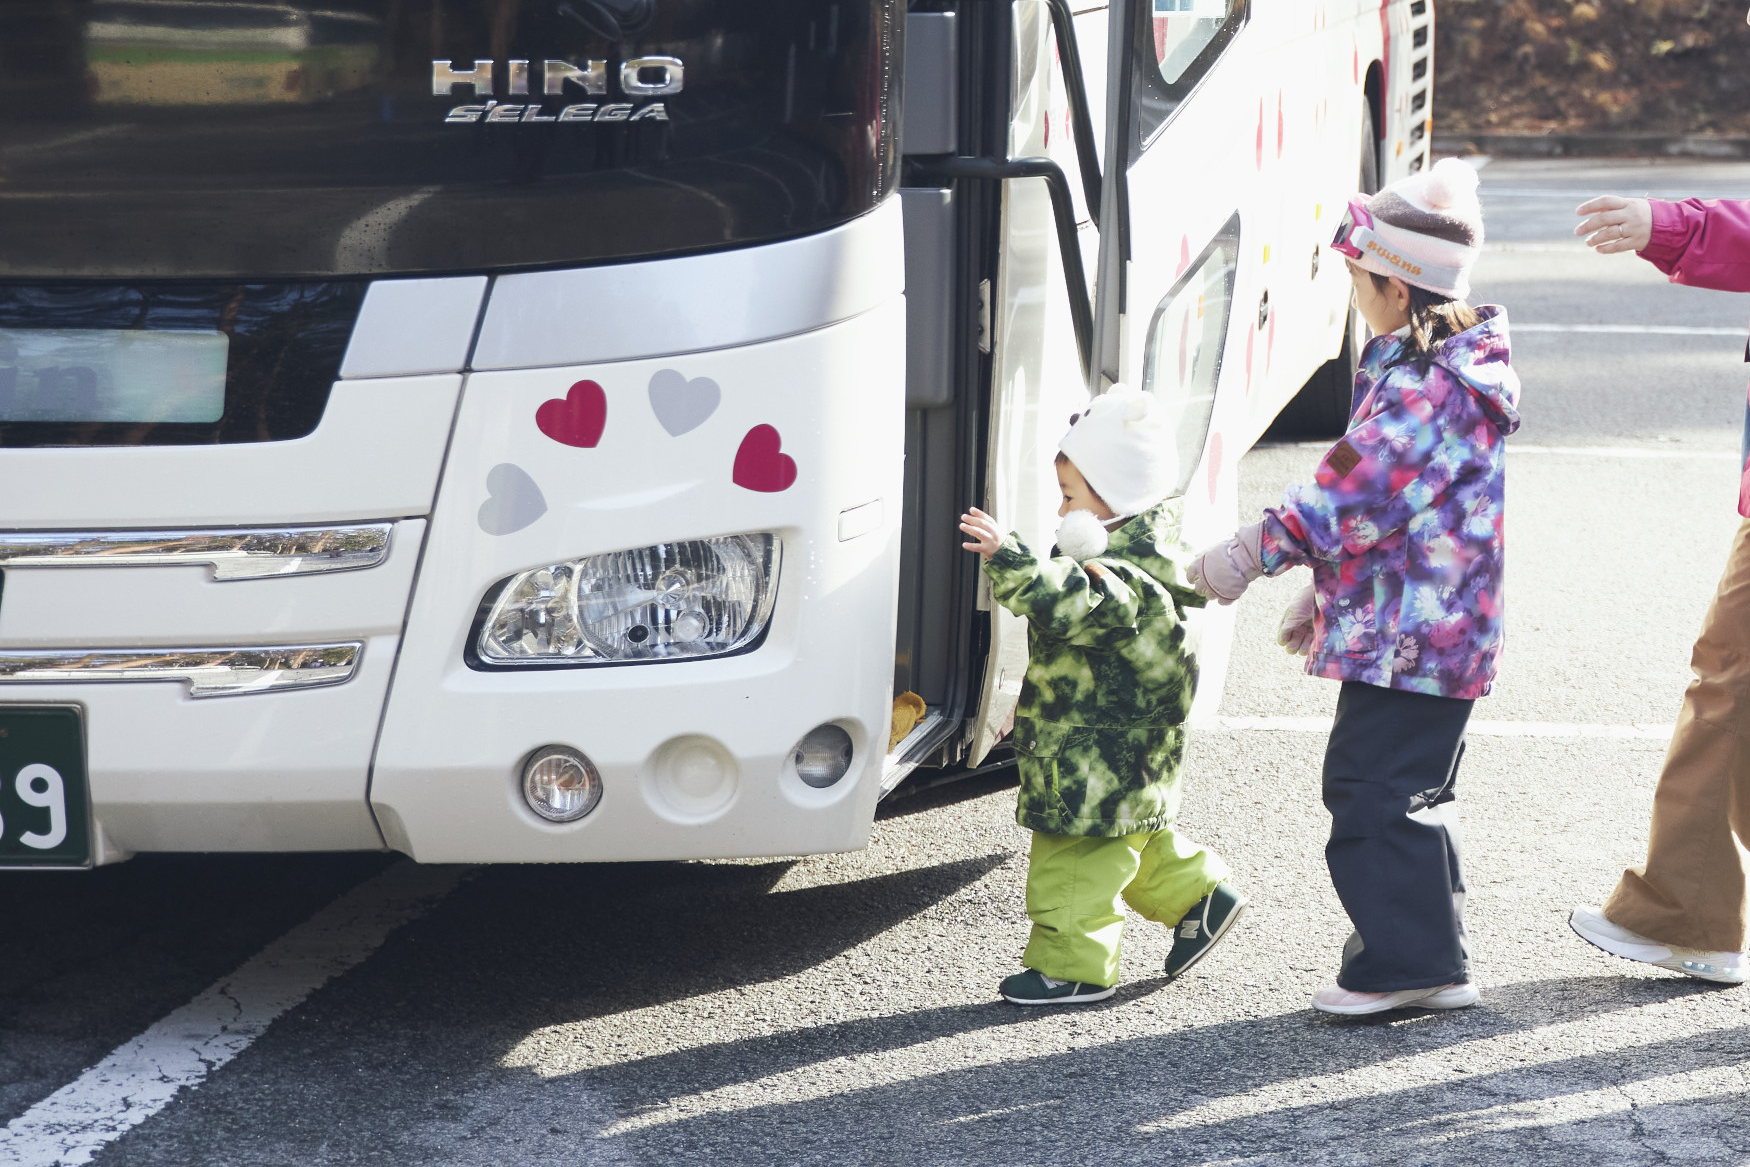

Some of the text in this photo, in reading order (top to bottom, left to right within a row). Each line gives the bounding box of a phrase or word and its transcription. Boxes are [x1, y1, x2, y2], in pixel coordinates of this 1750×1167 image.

[432, 56, 684, 95] HINO
[0, 763, 67, 849] 9
[1179, 920, 1201, 939] N
